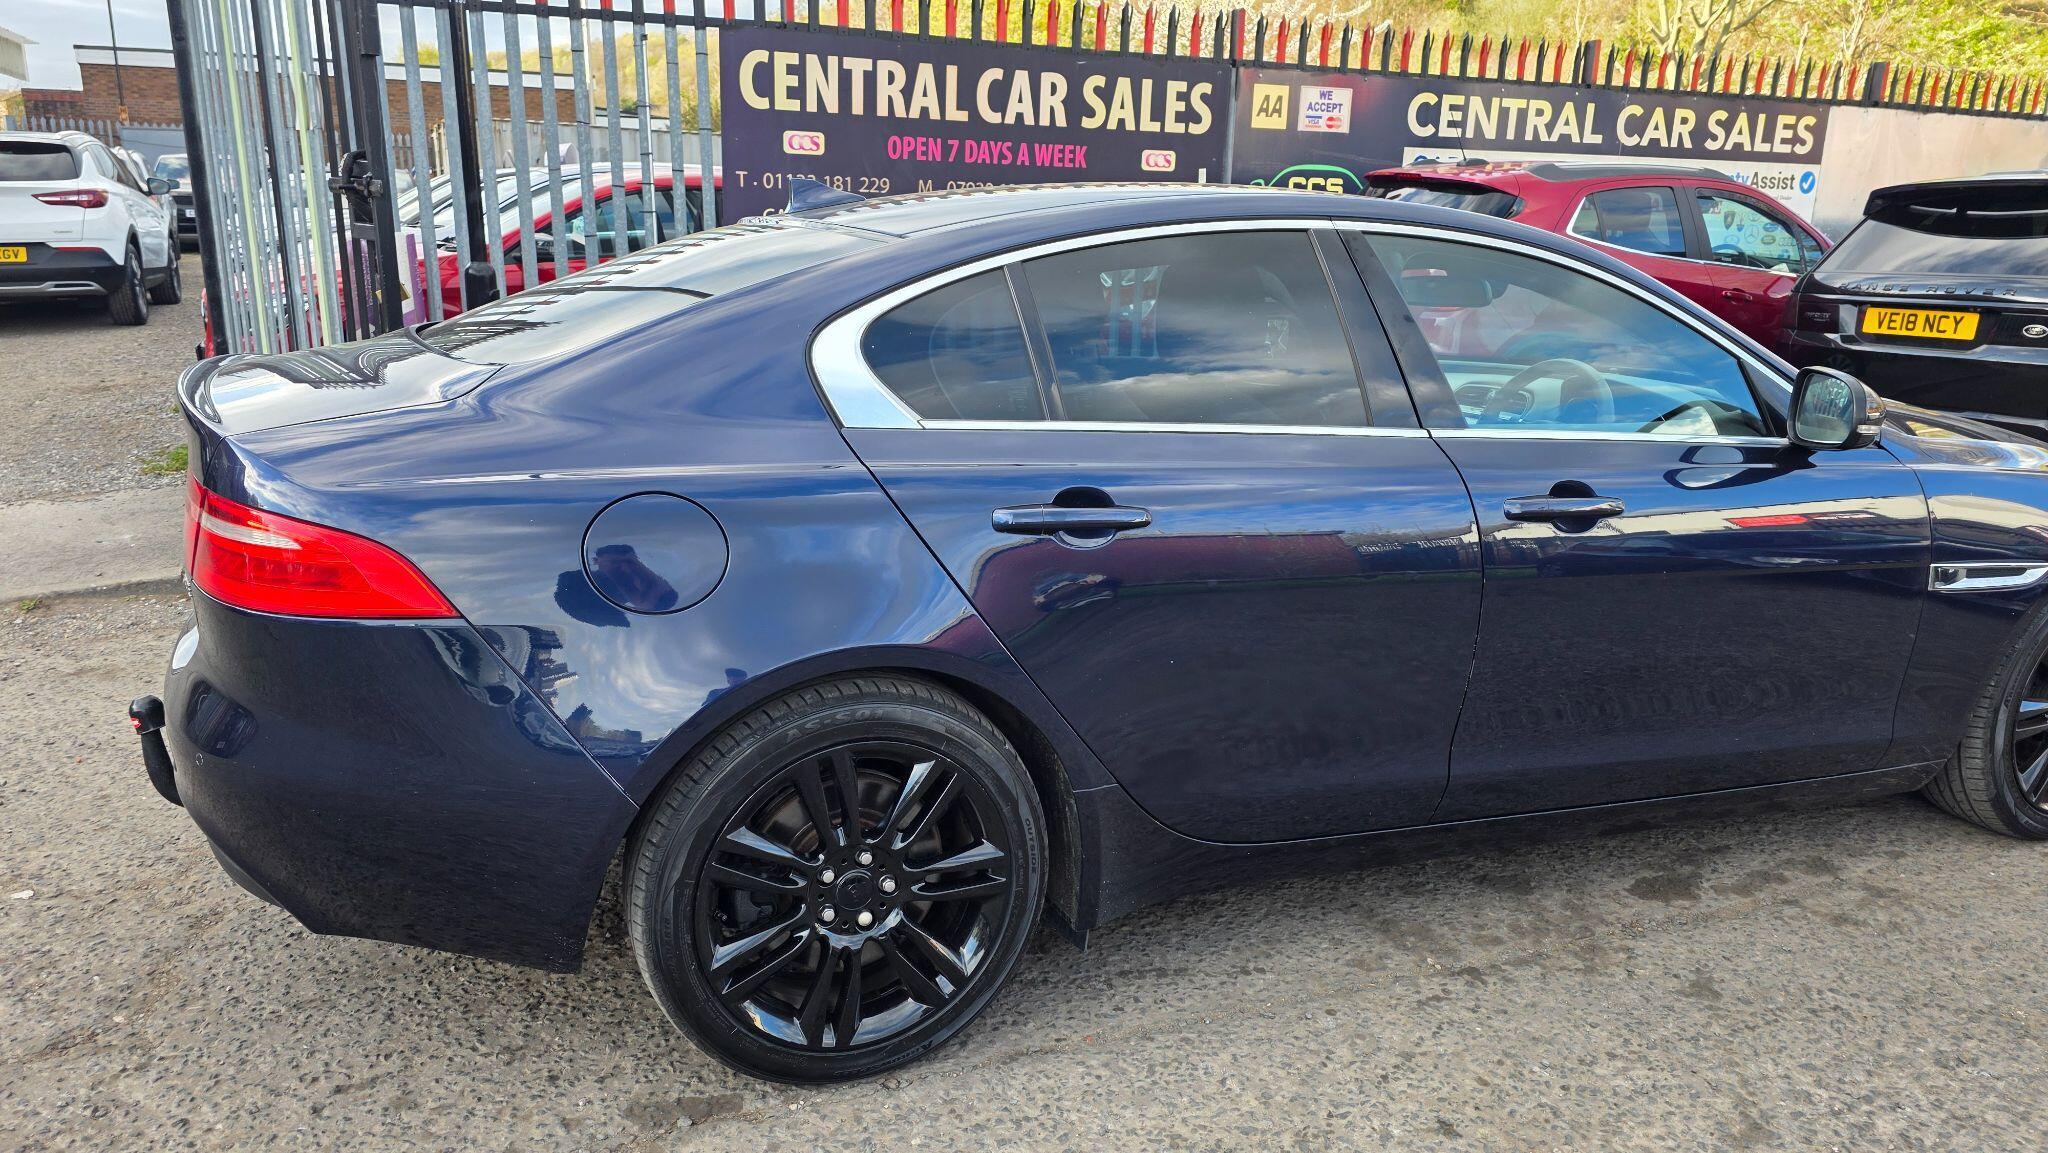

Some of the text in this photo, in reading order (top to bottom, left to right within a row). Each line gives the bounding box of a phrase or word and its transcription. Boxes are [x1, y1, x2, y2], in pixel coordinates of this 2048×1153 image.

[739, 49, 1213, 135] CENTRAL CAR SALES
[1319, 90, 1334, 101] WE
[1256, 94, 1283, 118] AA
[1306, 102, 1344, 114] ACCEPT
[1407, 92, 1817, 155] CENTRAL CAR SALES
[788, 134, 820, 151] CCS
[887, 135, 1088, 168] OPEN 7 DAYS A WEEK
[859, 177, 890, 194] 229
[1750, 171, 1796, 190] Assist
[0, 248, 20, 260] GV
[1838, 282, 2018, 296] RANGE ROVER
[1876, 311, 1965, 335] VE18 NCY
